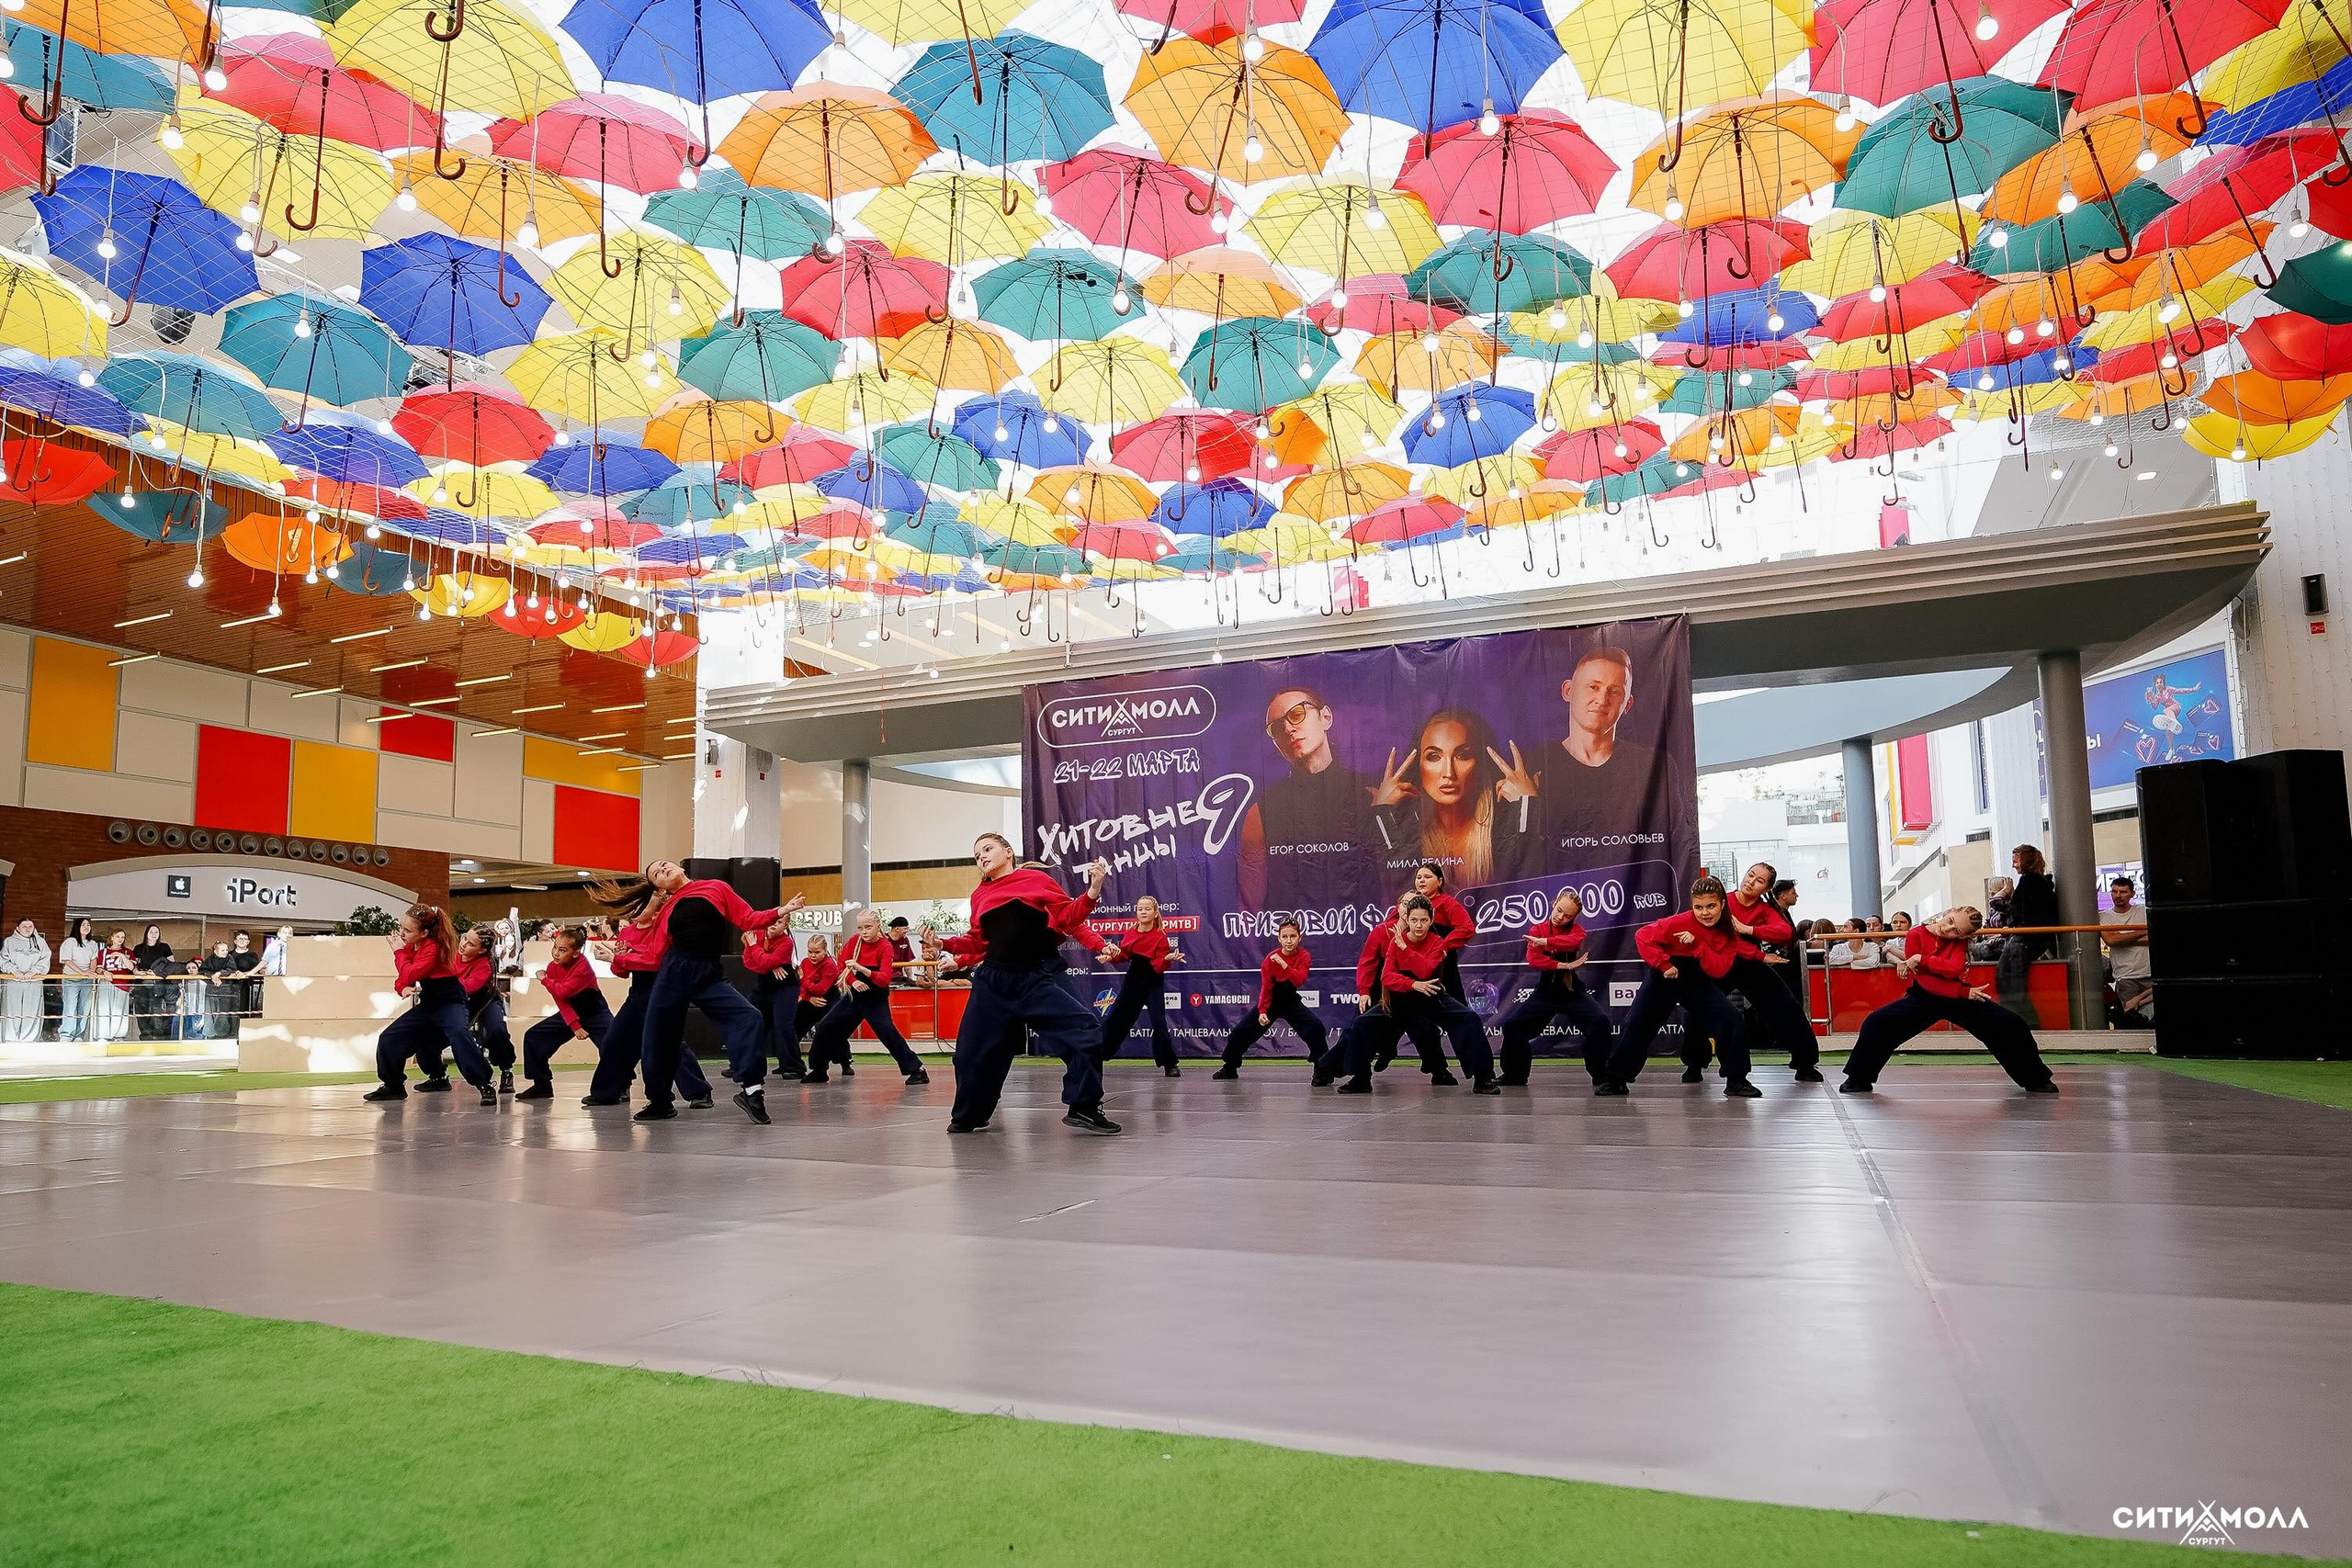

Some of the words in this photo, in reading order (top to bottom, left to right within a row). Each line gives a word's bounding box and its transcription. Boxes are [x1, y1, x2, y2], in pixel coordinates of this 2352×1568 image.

[1052, 705, 1113, 728] СИТИ
[1131, 697, 1201, 720] МОЛЛ
[1107, 728, 1136, 737] СУРГУТ
[1053, 757, 1124, 784] 21-22
[1127, 748, 1201, 777] МАРТА
[1037, 801, 1200, 865] ХИТОВЫЕ
[1562, 837, 1599, 848] ИГОРЬ
[1600, 833, 1665, 846] СОЛОВЬЕВ
[1270, 844, 1294, 855] ЕГОР
[1296, 842, 1350, 854] СОКОЛОВ
[1386, 859, 1419, 869] МИЛА
[226, 878, 297, 907] iPort
[1476, 890, 1549, 933] 250
[1555, 879, 1624, 918] 00
[1634, 893, 1668, 909] RUB
[1204, 995, 1250, 1004] YAMAGUCHI
